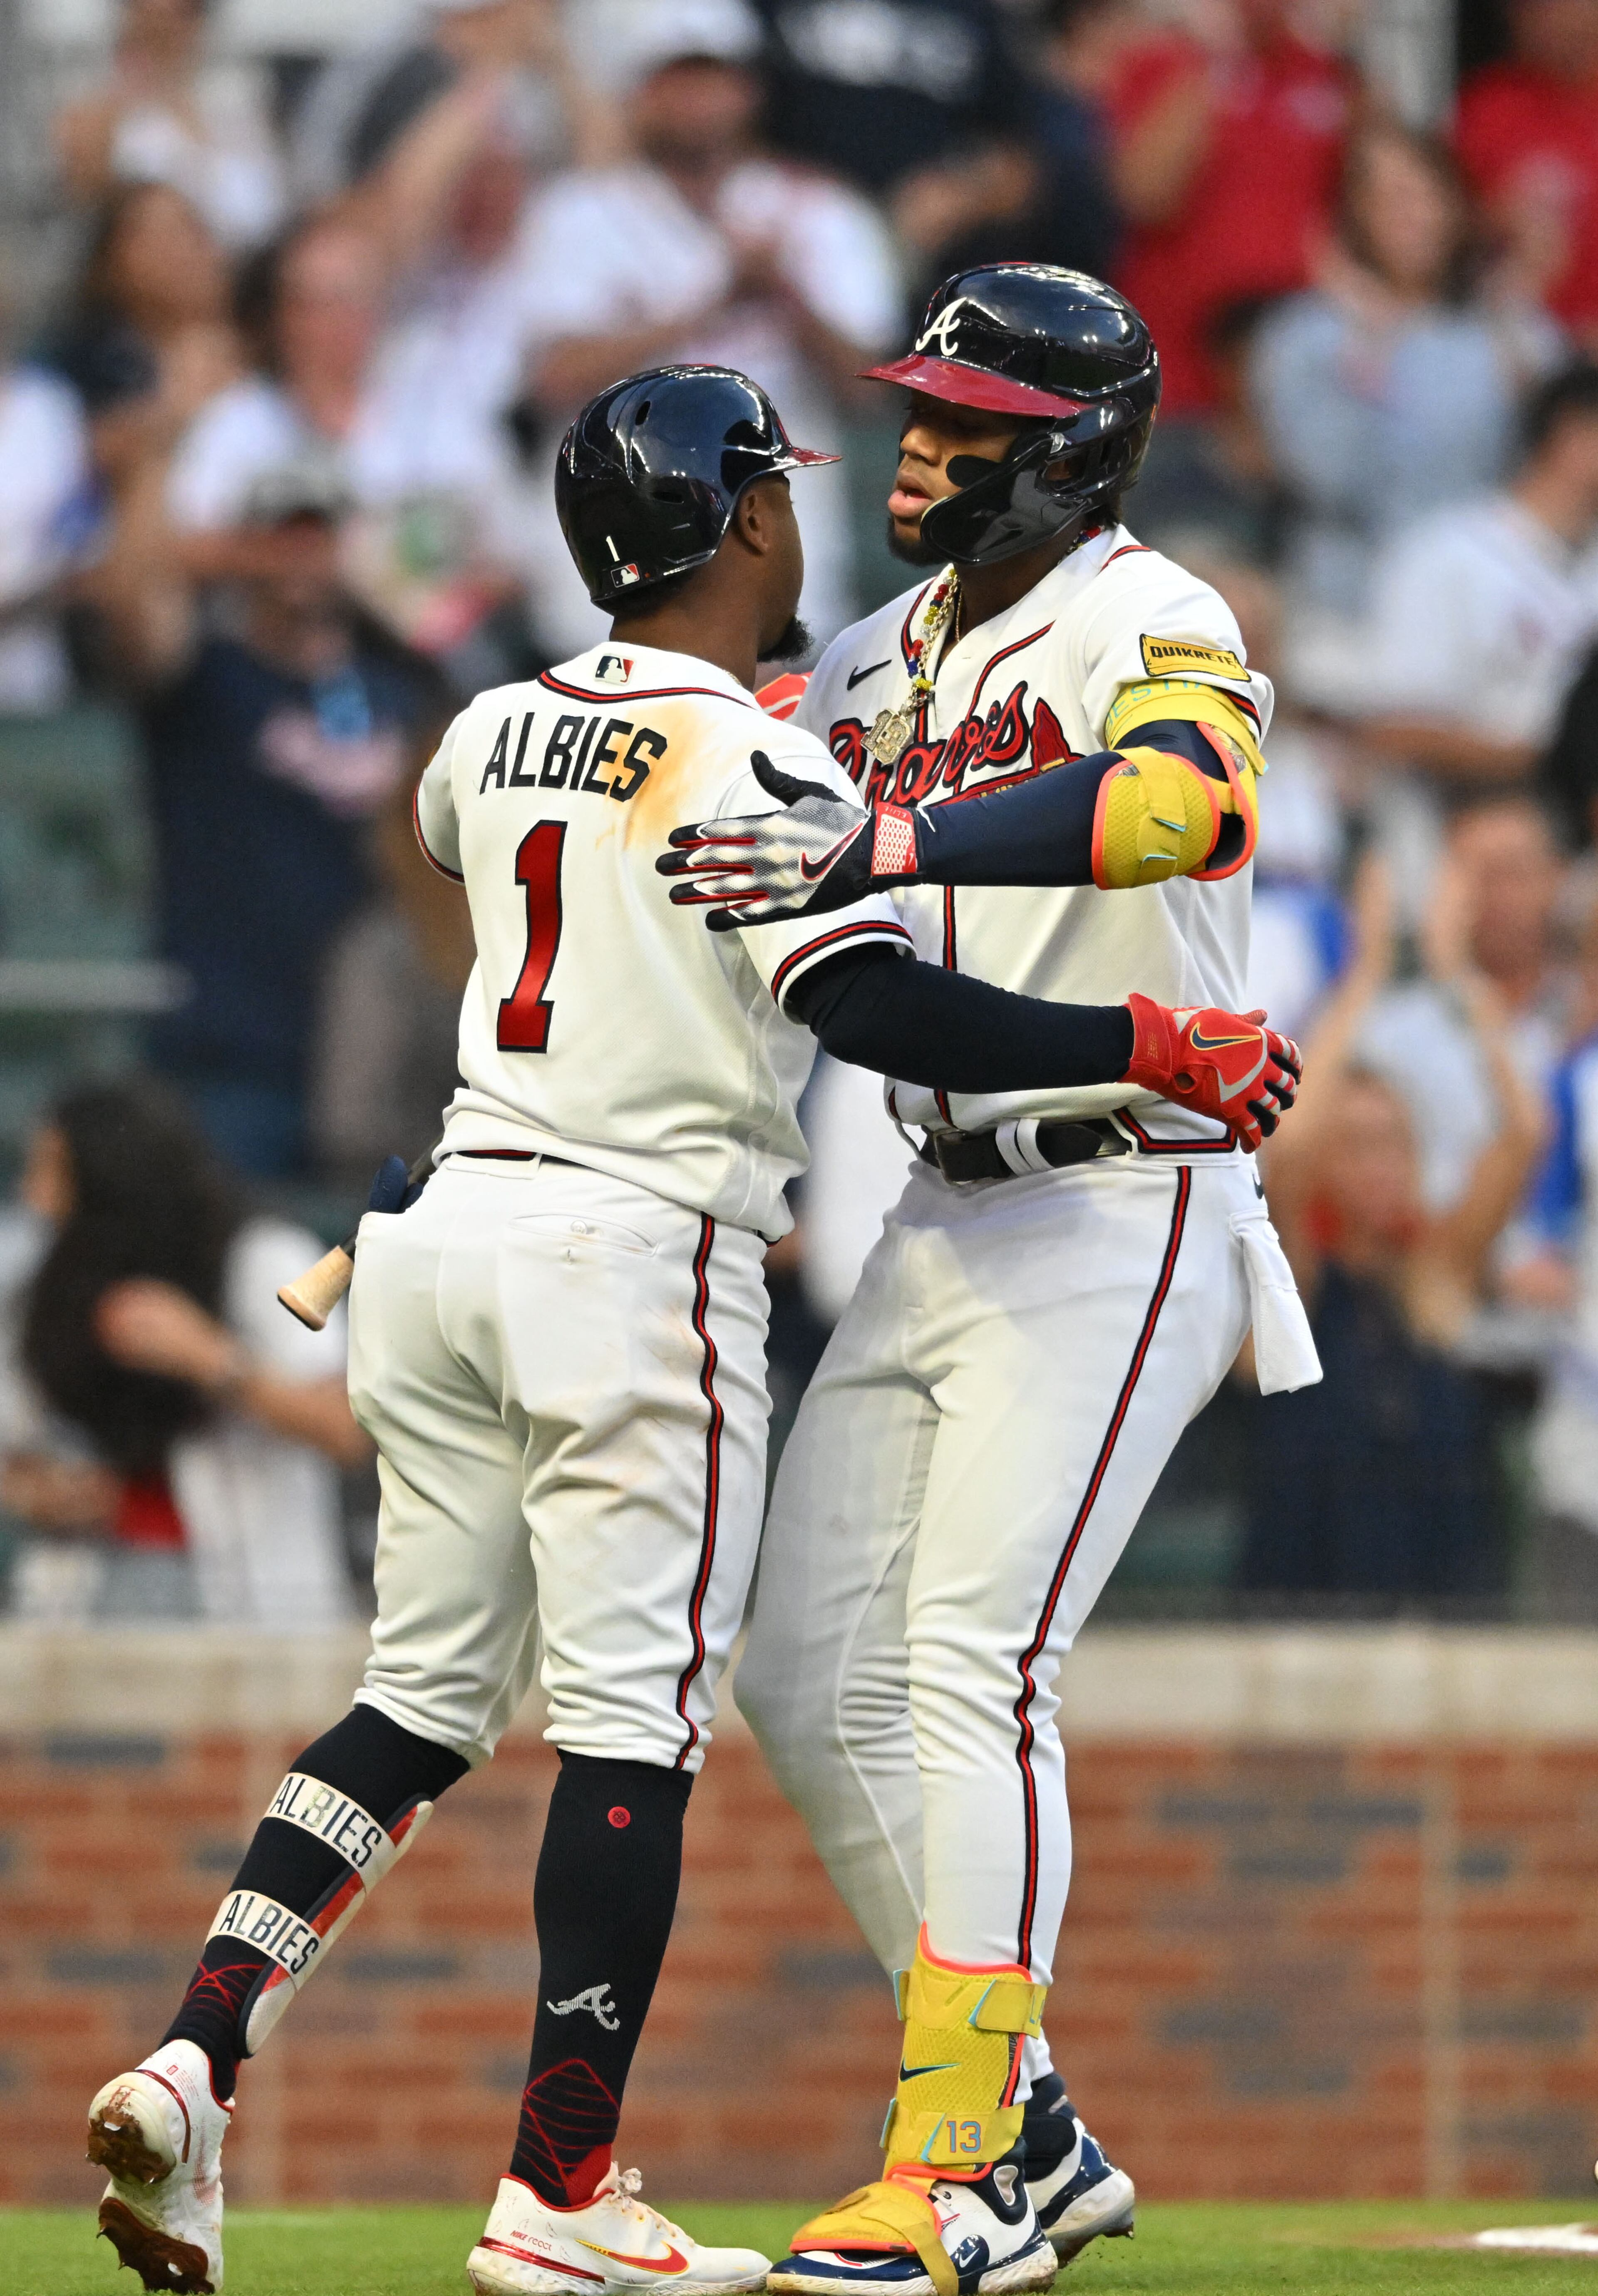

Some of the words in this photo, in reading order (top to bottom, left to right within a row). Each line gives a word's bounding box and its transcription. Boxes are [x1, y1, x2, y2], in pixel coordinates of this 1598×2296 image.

[916, 297, 967, 356] A
[605, 536, 620, 562] 1
[1149, 646, 1236, 666] QUIKRETE
[479, 712, 667, 802] ALBIES
[496, 819, 568, 1053] 1
[270, 1776, 382, 1868] ALBIES
[218, 1894, 319, 1975] ALBIES
[546, 1983, 620, 2030] A
[946, 2120, 981, 2153] 13
[510, 2230, 528, 2241] NIKE
